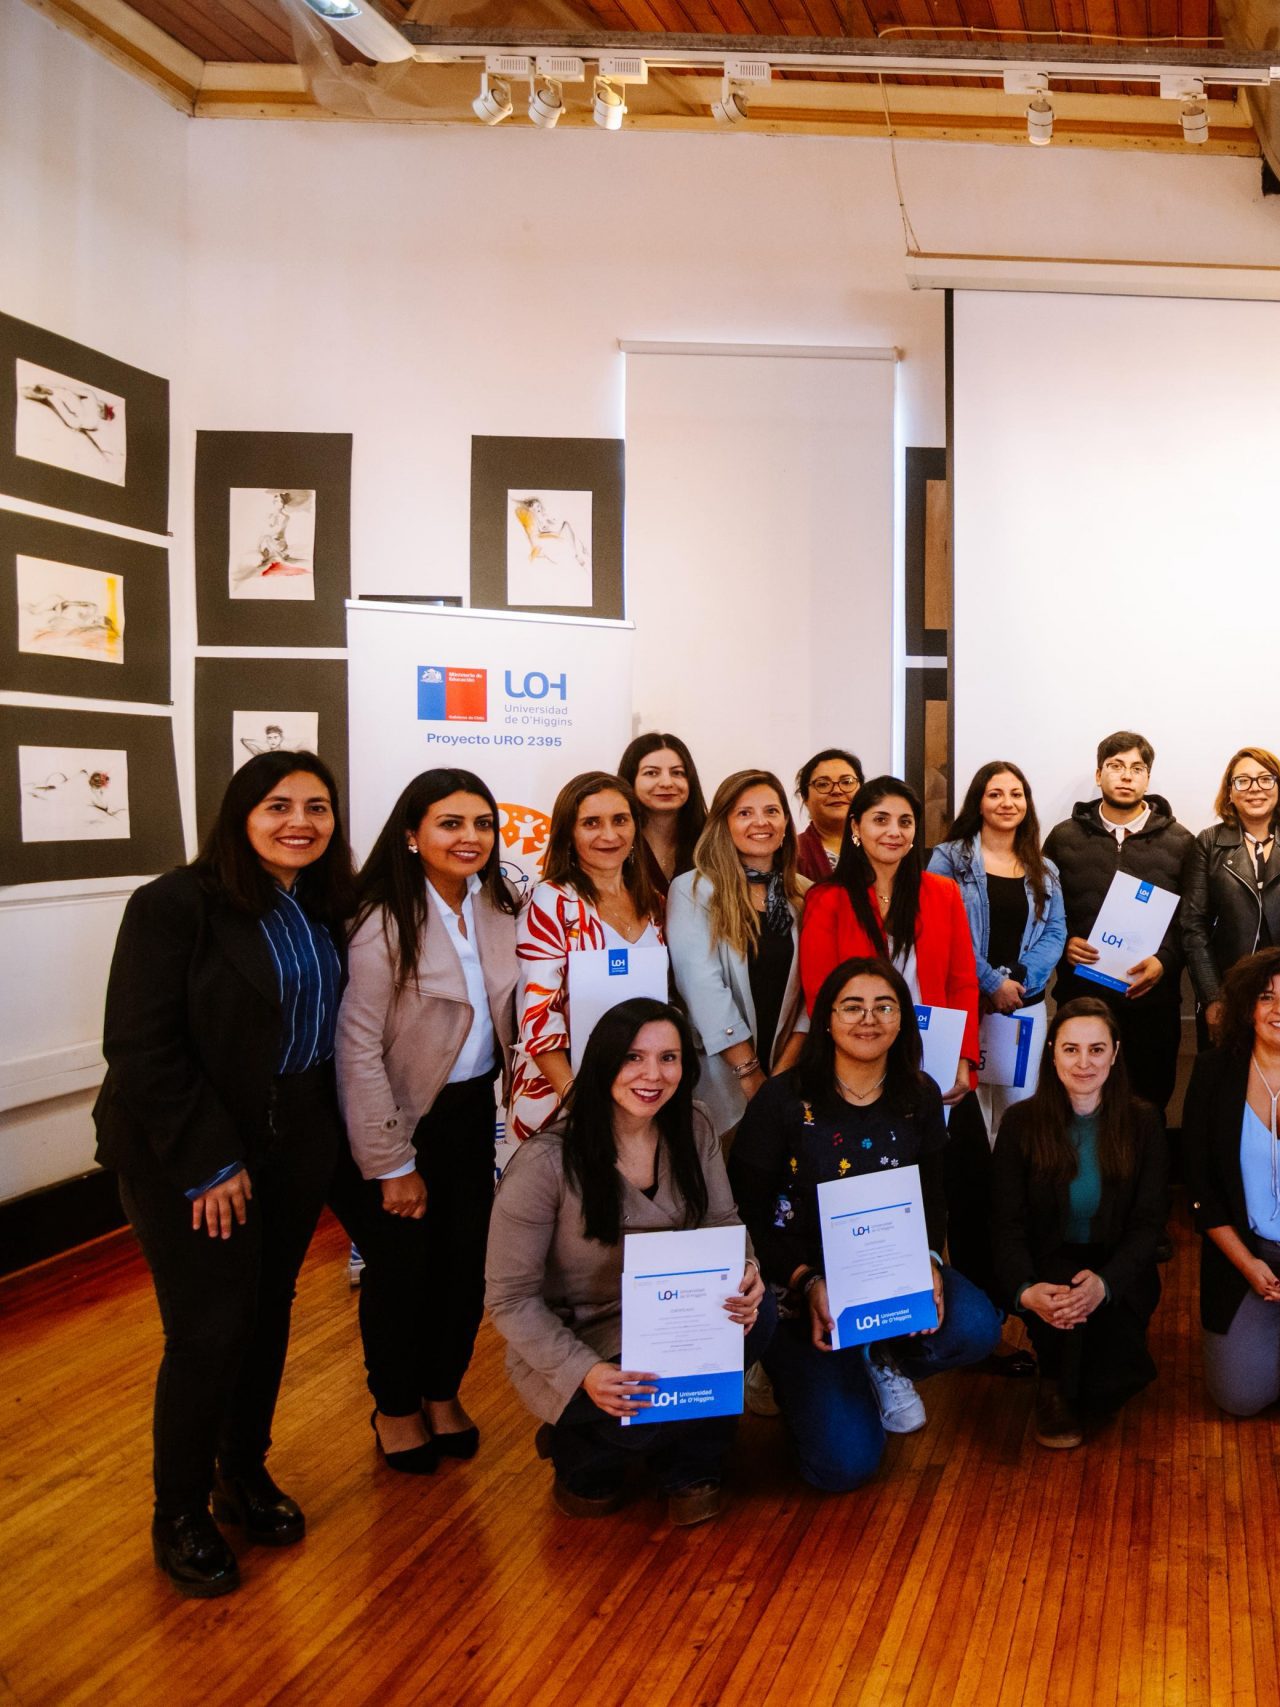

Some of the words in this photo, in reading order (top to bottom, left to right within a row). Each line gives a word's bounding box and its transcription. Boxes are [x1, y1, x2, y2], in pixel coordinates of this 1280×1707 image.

[504, 670, 567, 700] UOH
[504, 704, 568, 715] Universidad
[504, 715, 518, 724] de
[521, 716, 573, 727] O'Higgins
[427, 733, 490, 746] Proyecto
[494, 735, 524, 746] URO
[527, 736, 562, 747] 2395
